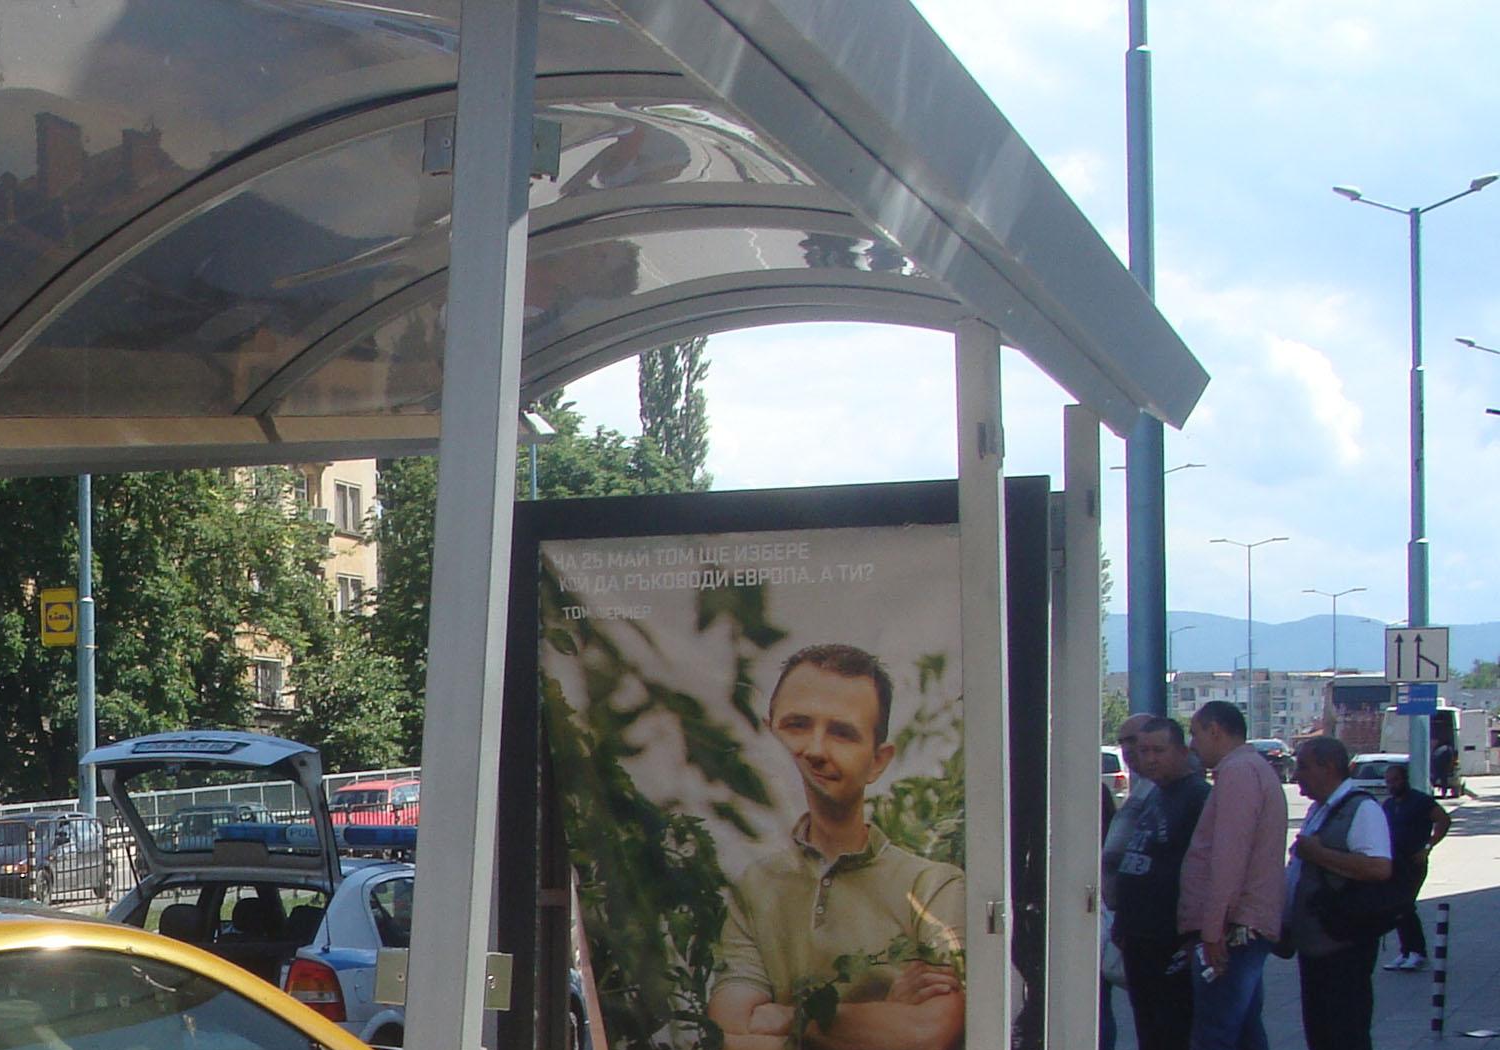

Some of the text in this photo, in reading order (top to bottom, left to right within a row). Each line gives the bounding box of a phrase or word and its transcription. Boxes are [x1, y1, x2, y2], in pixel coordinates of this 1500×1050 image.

[582, 551, 603, 569] 25
[658, 547, 694, 566] ТОМ
[699, 545, 731, 566] ЩЕ
[734, 542, 811, 562] ИЗБЕРЕ
[594, 574, 620, 594] ДА
[624, 568, 729, 591] РЪКОВОДИ
[734, 565, 817, 587] ЕВРОПА.
[820, 565, 833, 583] А
[836, 563, 875, 583] ТИ?
